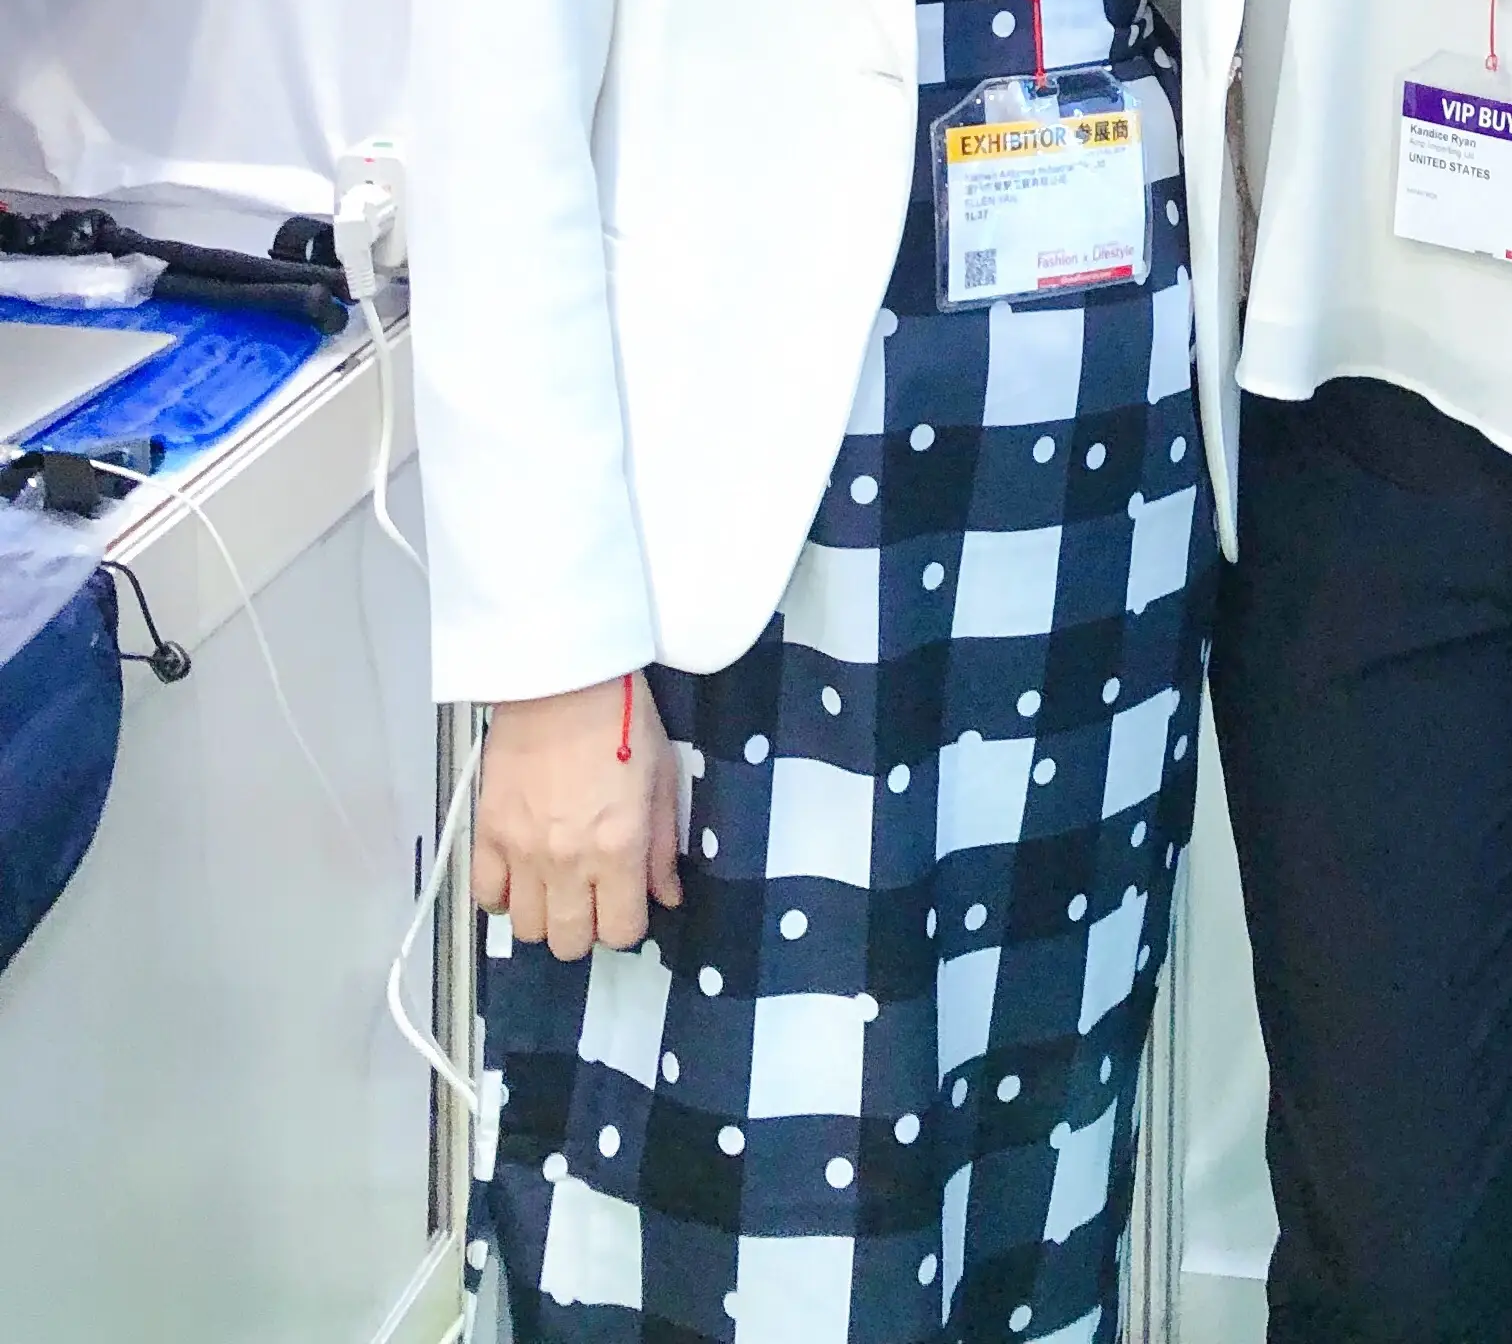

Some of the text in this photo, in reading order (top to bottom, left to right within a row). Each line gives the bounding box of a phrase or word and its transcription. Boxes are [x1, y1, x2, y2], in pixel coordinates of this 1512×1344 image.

[1441, 98, 1475, 124] VIP
[961, 126, 1066, 157] EXHIBITOR
[1410, 124, 1477, 148] Kandice Ryan
[1408, 152, 1446, 170] UNITED
[1449, 160, 1491, 180] STATES
